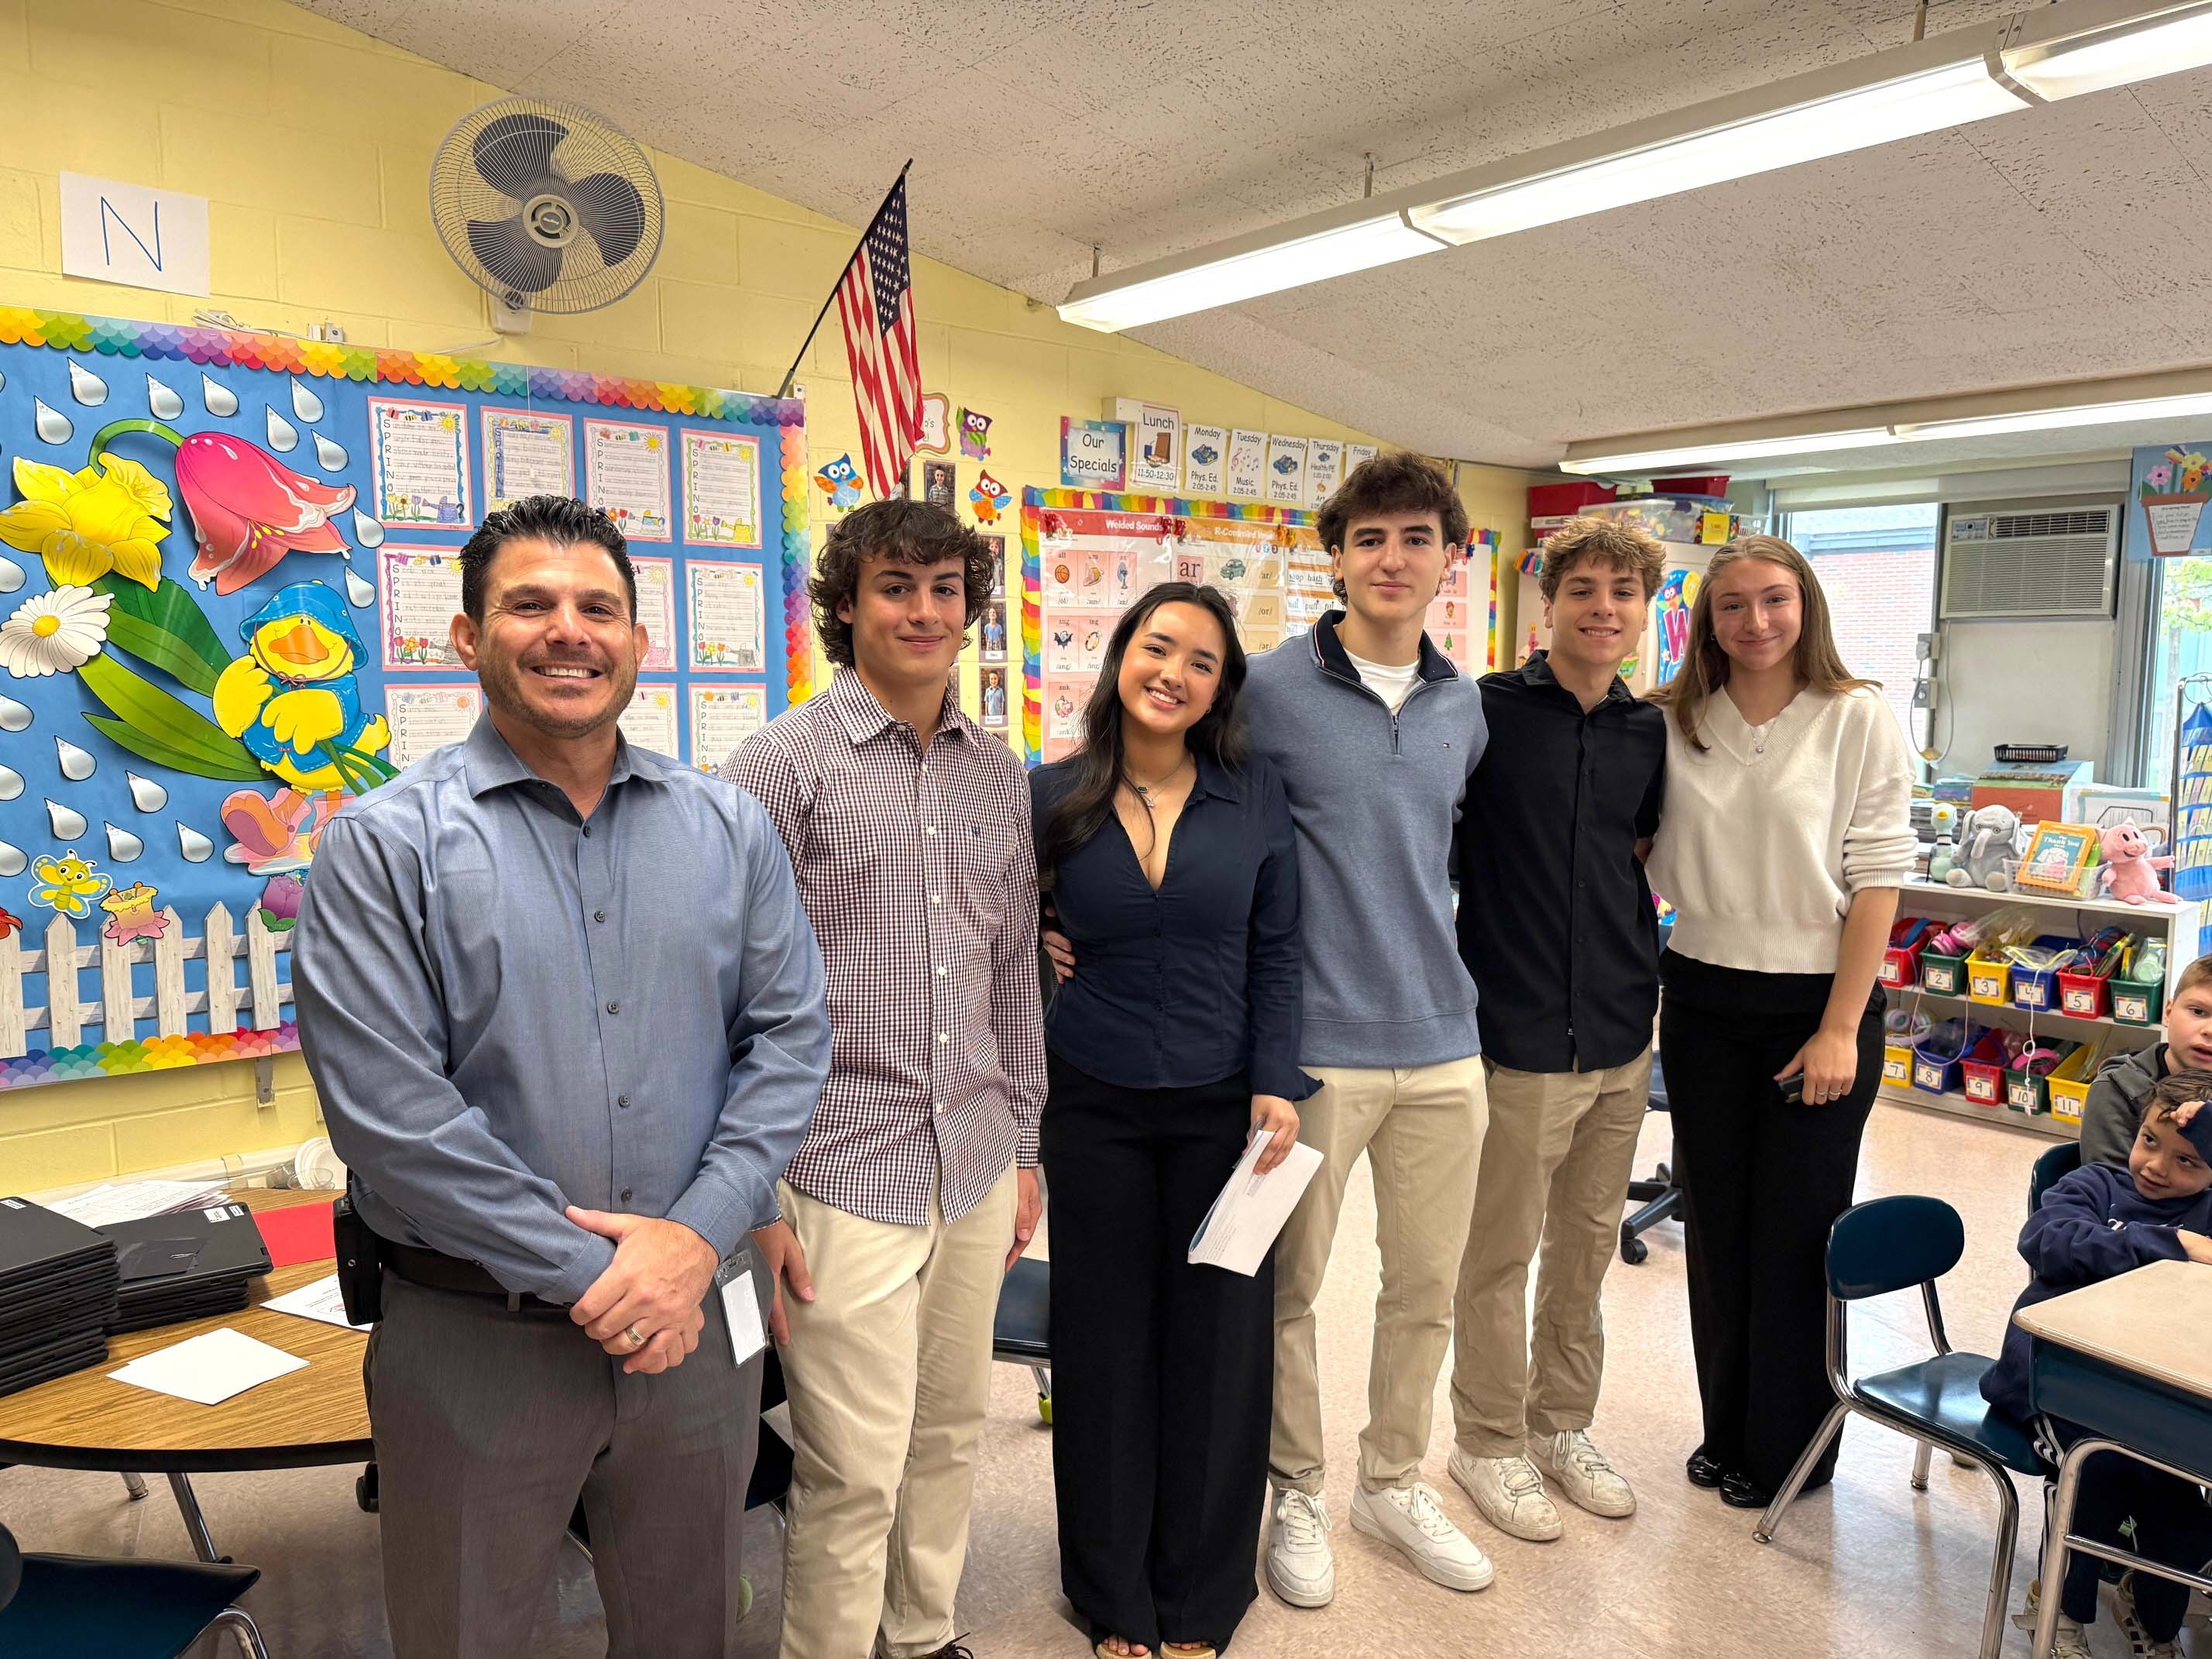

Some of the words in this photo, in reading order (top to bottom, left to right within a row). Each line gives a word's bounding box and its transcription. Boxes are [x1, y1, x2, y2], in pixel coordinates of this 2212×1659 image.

[100, 195, 163, 272] N
[1143, 413, 1174, 430] Lunch
[1195, 427, 1221, 440] Monday
[1237, 432, 1262, 445] Tuesday
[1083, 434, 1104, 448] Our
[1273, 438, 1306, 452] Wednesday
[1313, 441, 1340, 453] Thursday
[1353, 446, 1371, 455] Friday
[1070, 455, 1117, 472] Specials
[1138, 469, 1174, 481] 11:50-12:30
[1191, 471, 1207, 483] Phys.
[1209, 472, 1218, 483] Ed.
[1236, 477, 1254, 486] Music
[1272, 480, 1289, 490] Phys.
[1290, 482, 1299, 491] Ed.
[1106, 520, 1135, 530] Welded
[1180, 561, 1200, 578] ar
[1935, 974, 1943, 985] 2
[1980, 980, 1990, 994] 3
[2073, 995, 2083, 1008] 5
[2125, 1003, 2135, 1015] 6
[1889, 1064, 1899, 1076] 7
[1925, 1070, 1933, 1084] 8
[1975, 1081, 1983, 1094] 9
[2017, 1091, 2028, 1103] 10
[2063, 1099, 2072, 1111] 11
